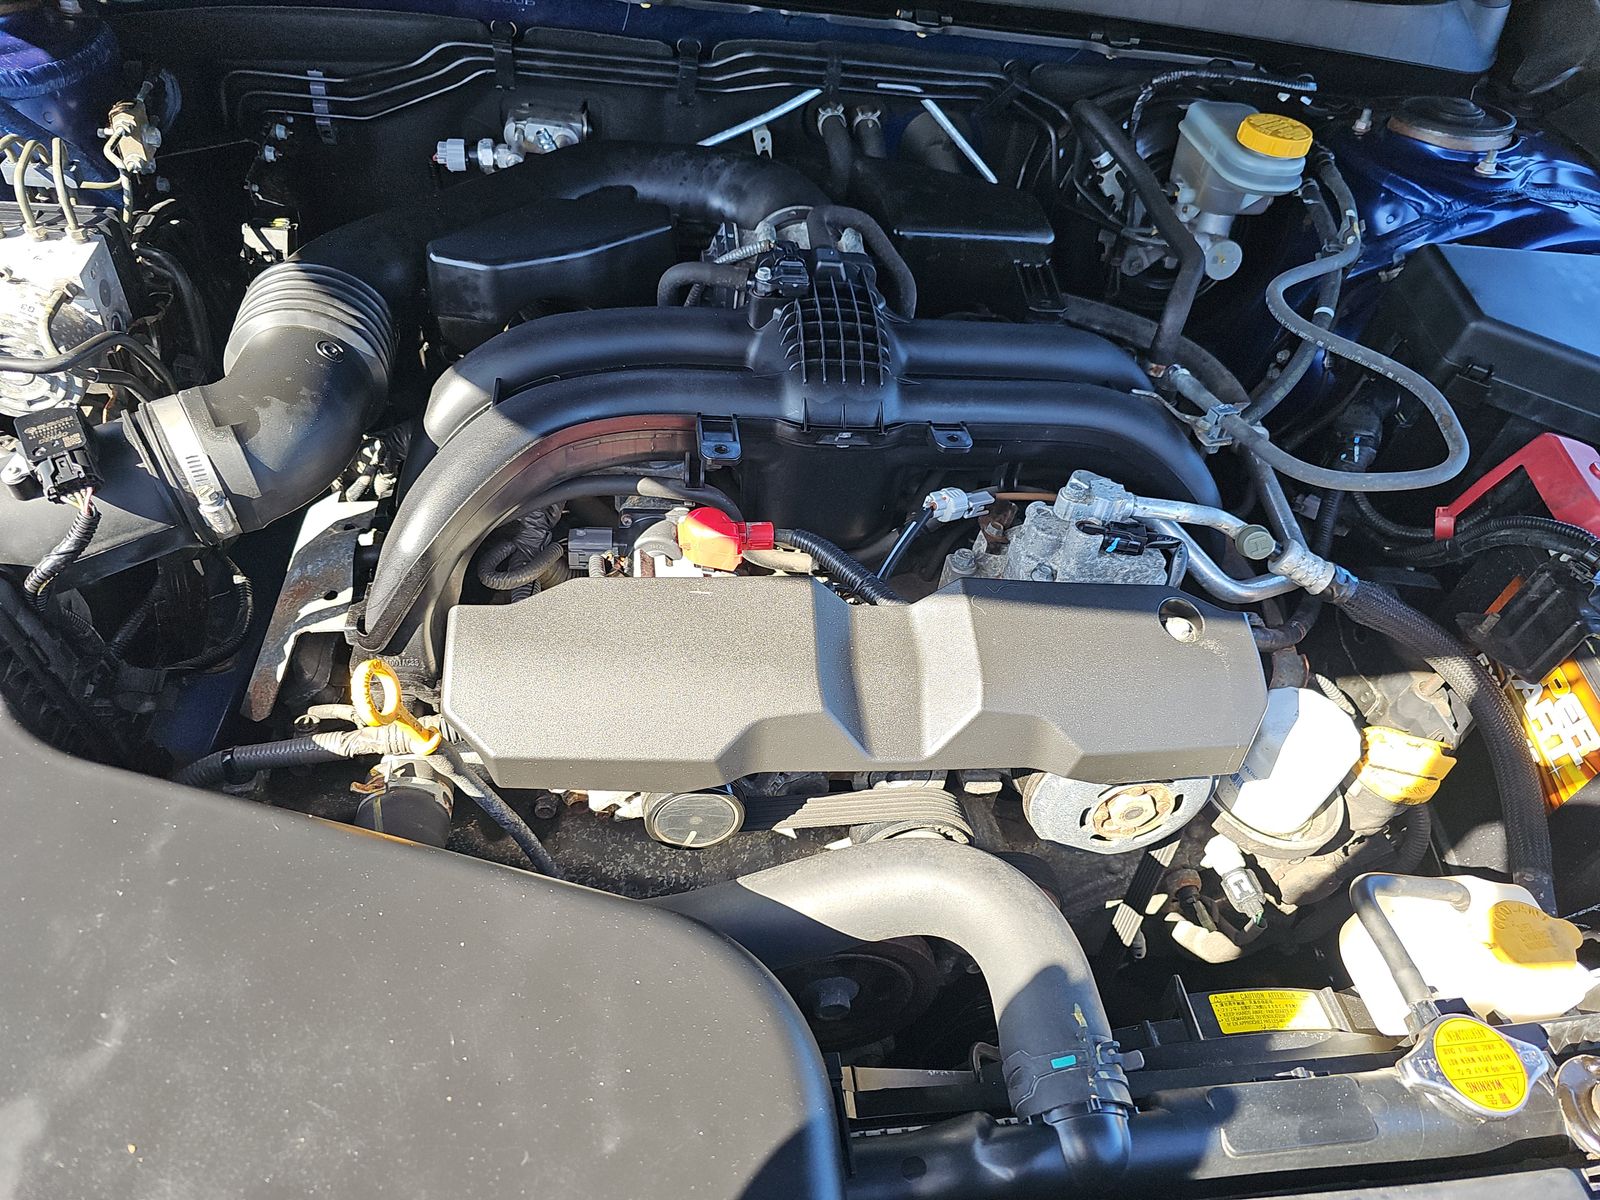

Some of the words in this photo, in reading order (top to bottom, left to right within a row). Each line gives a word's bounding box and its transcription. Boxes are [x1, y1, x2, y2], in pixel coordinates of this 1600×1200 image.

[1510, 679, 1584, 766] ART
[1541, 667, 1600, 754] PER
[1240, 992, 1265, 1000] CAUTION
[1465, 1079, 1504, 1094] WARNING
